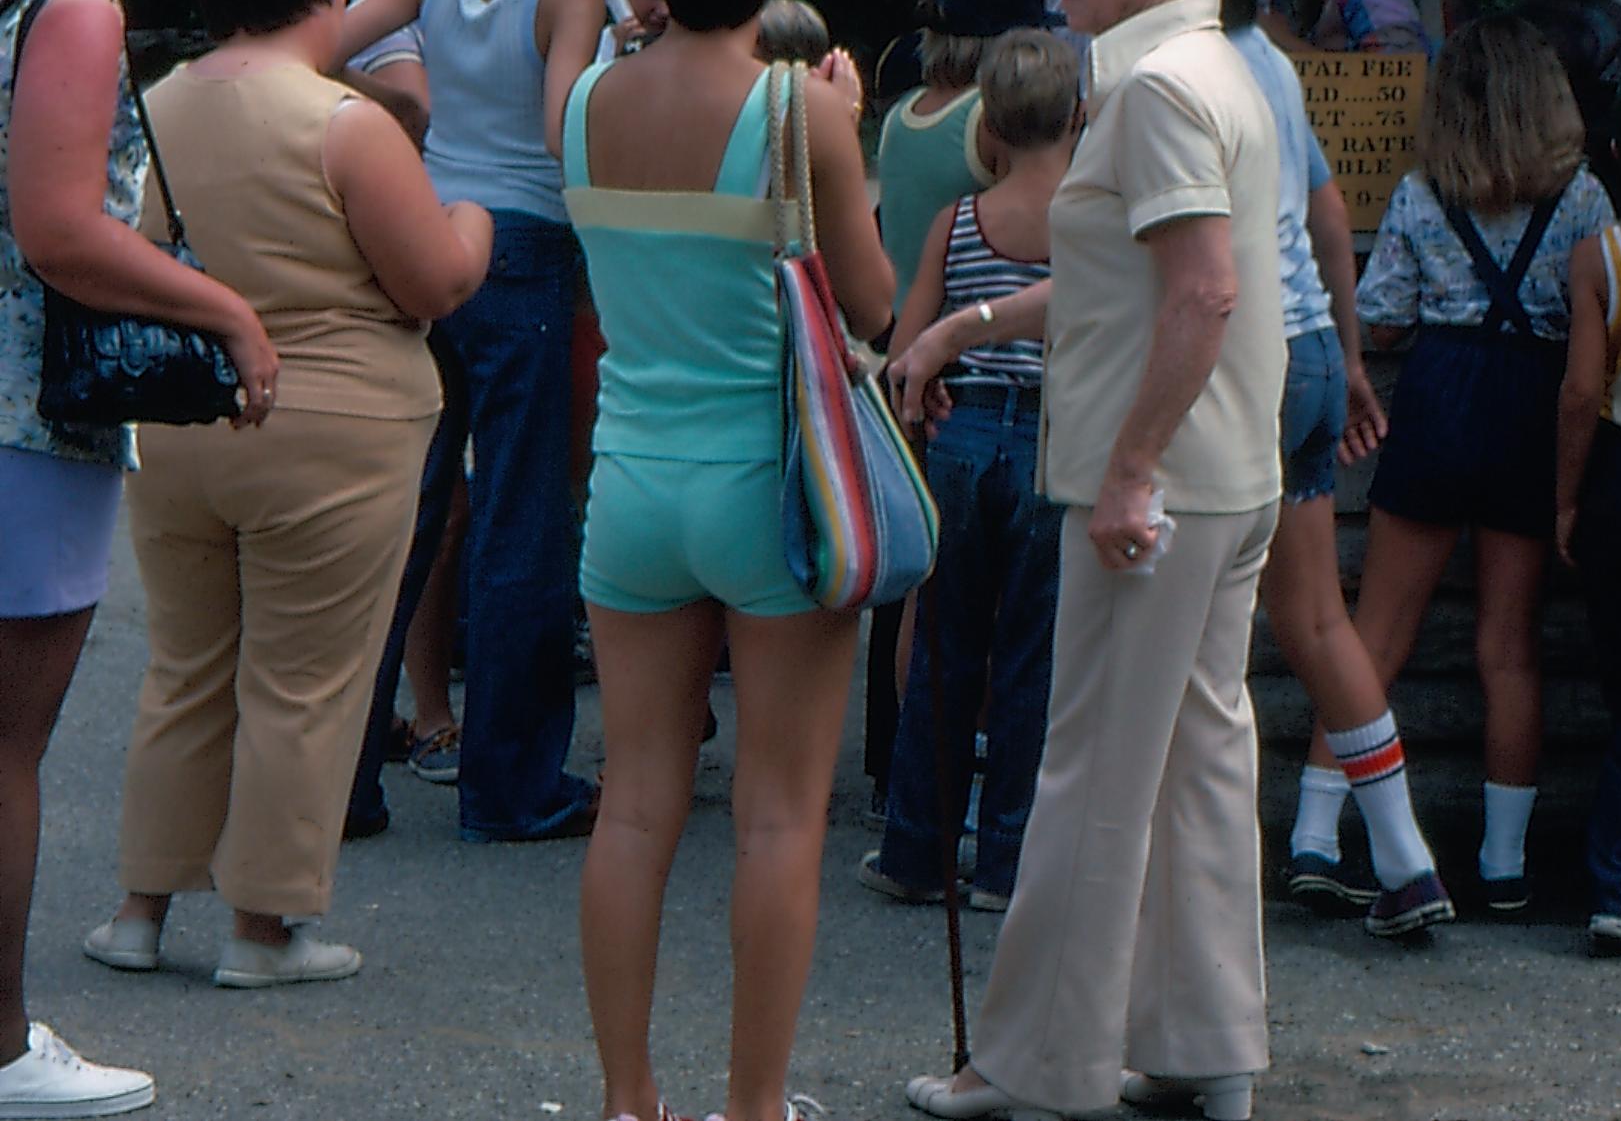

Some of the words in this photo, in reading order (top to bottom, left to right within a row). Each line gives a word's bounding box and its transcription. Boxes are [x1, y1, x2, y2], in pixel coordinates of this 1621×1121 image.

[1295, 60, 1348, 77] TAL
[1363, 60, 1411, 77] FEE
[1306, 87, 1338, 102] LD
[1306, 111, 1344, 127] LT
[1342, 136, 1415, 152] RATE
[1337, 159, 1391, 174] BLE
